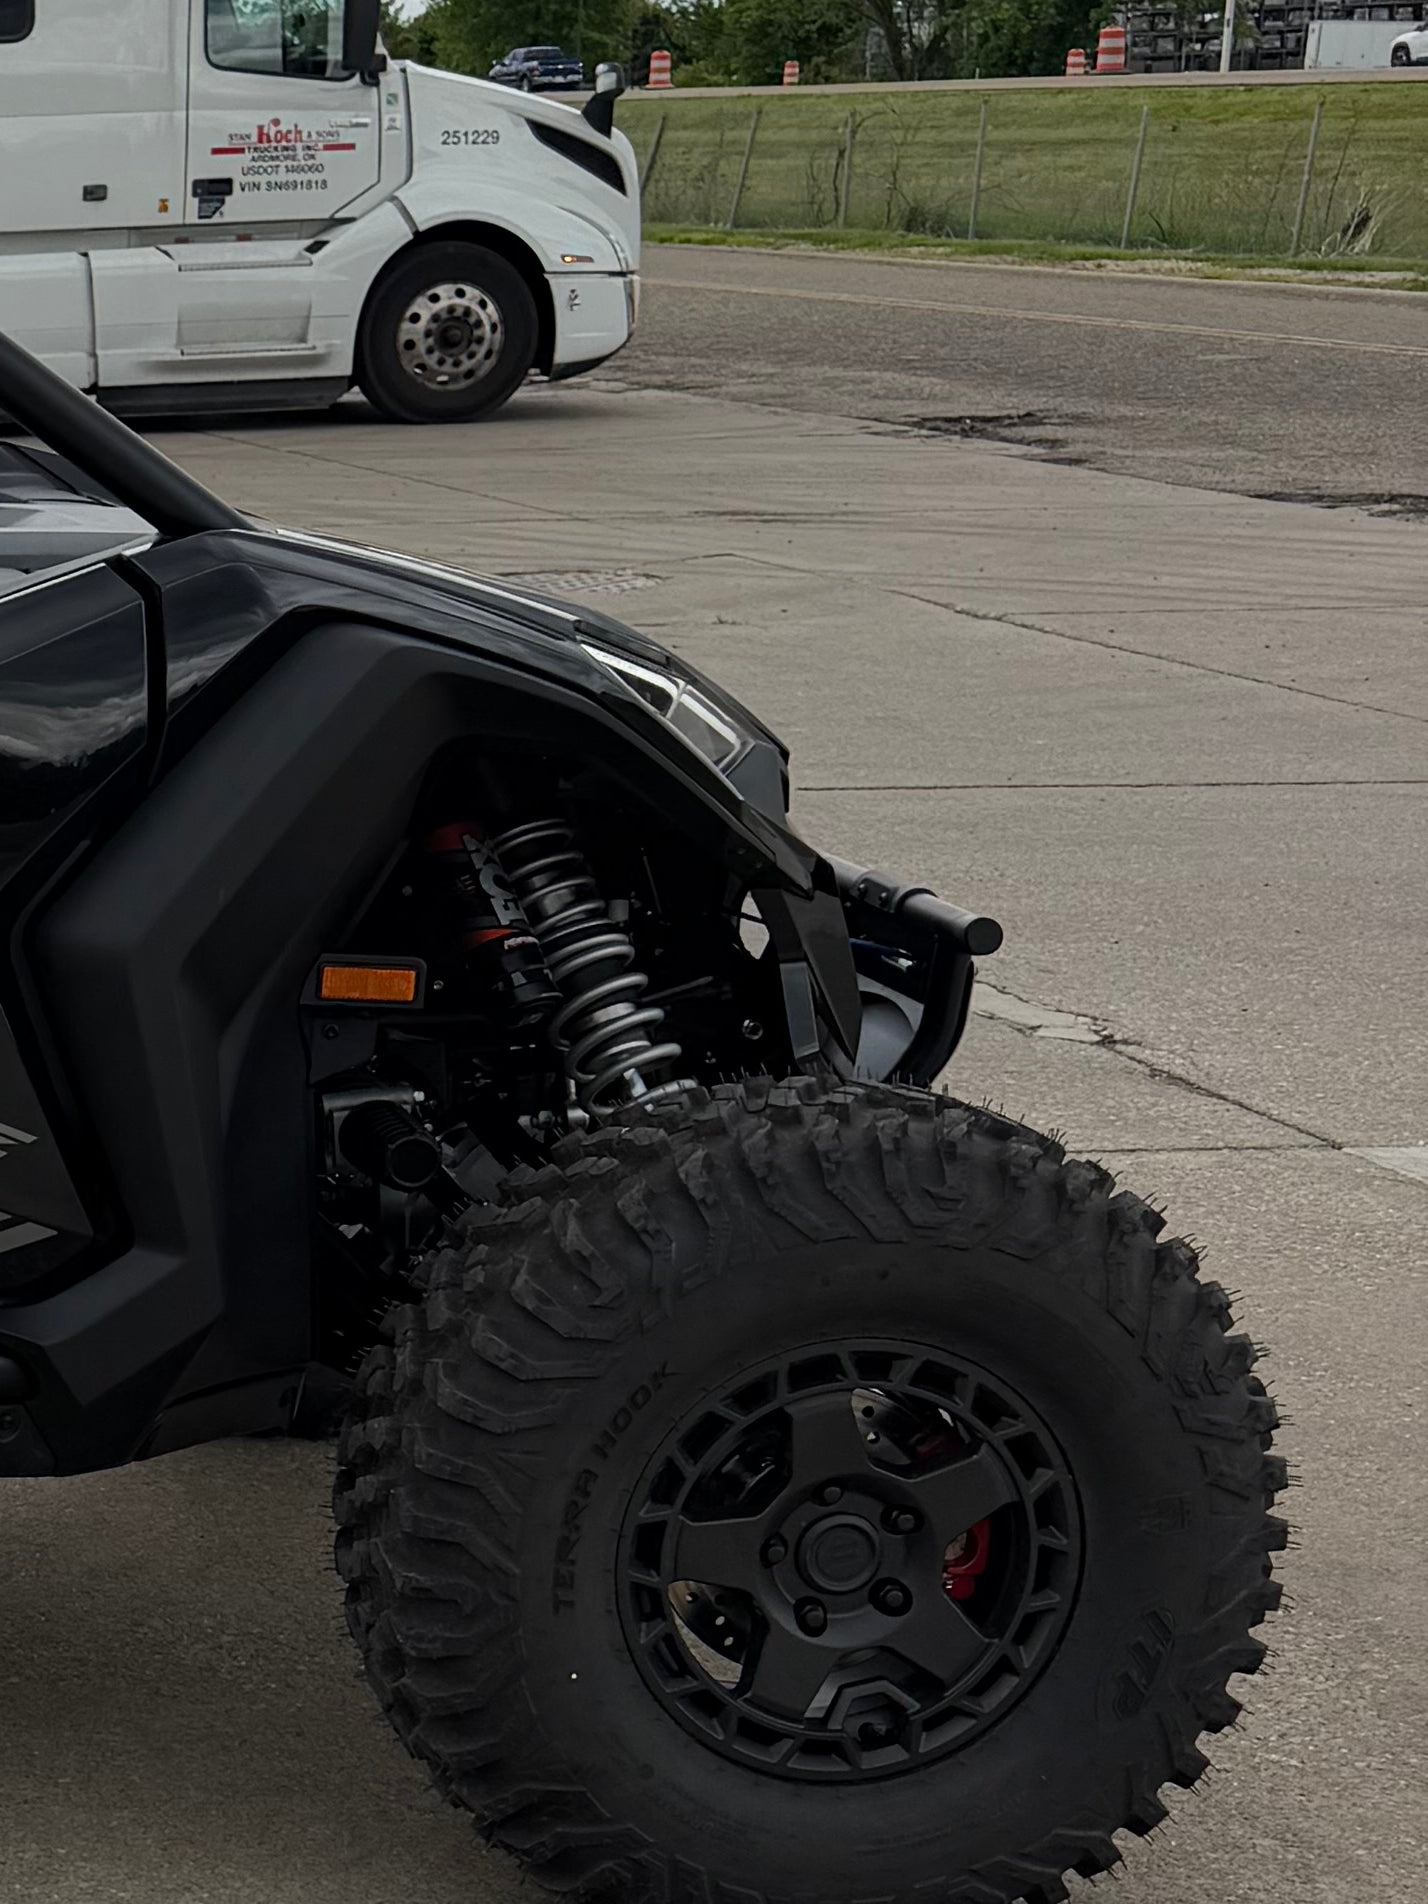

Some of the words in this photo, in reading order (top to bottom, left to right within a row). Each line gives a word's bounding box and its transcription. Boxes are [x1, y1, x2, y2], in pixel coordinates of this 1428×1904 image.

[255, 117, 304, 144] Koch
[440, 129, 501, 146] 251229
[246, 144, 298, 154] TRUCKING
[241, 164, 281, 177] USDOT
[239, 181, 262, 193] VIN
